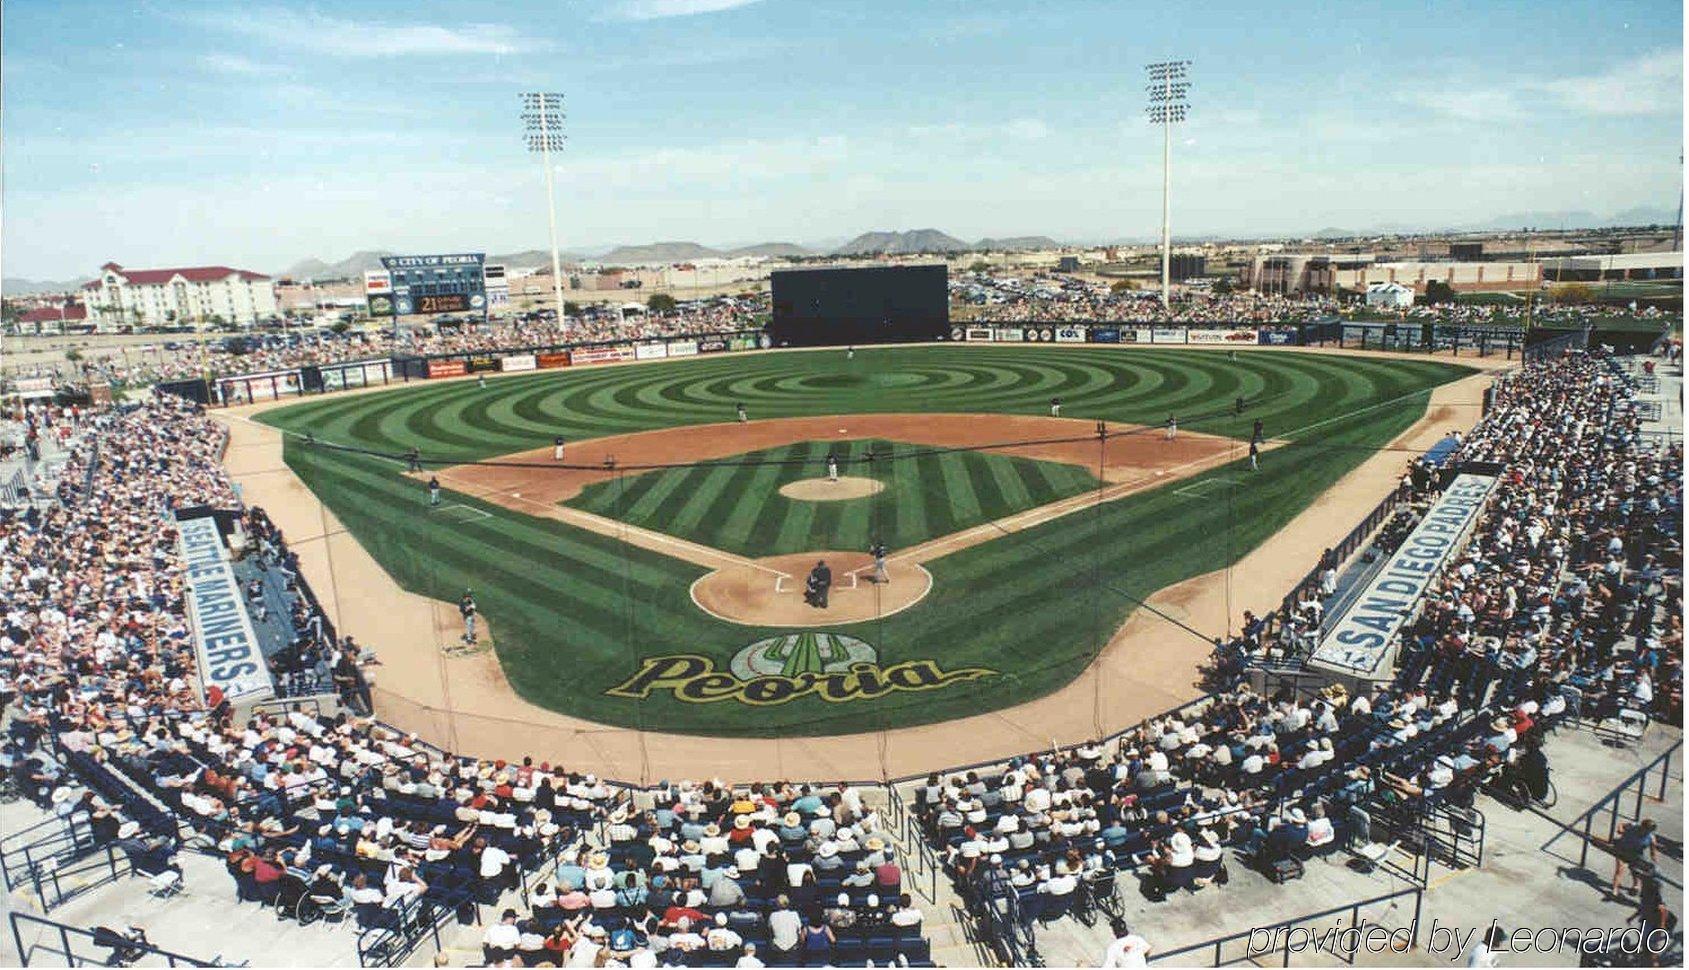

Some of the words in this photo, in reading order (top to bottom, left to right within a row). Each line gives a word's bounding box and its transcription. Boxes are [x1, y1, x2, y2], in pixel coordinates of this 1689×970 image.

[398, 257, 424, 265] CITY
[425, 257, 437, 265] OF
[442, 255, 478, 264] PEORIA
[422, 296, 437, 311] 21
[181, 523, 225, 578] SEATTLE
[1336, 596, 1409, 648] SAN
[1376, 535, 1451, 595] DIEGO
[1424, 483, 1488, 534] PADRES
[194, 578, 258, 681] MARINERS
[603, 653, 999, 707] Peoria
